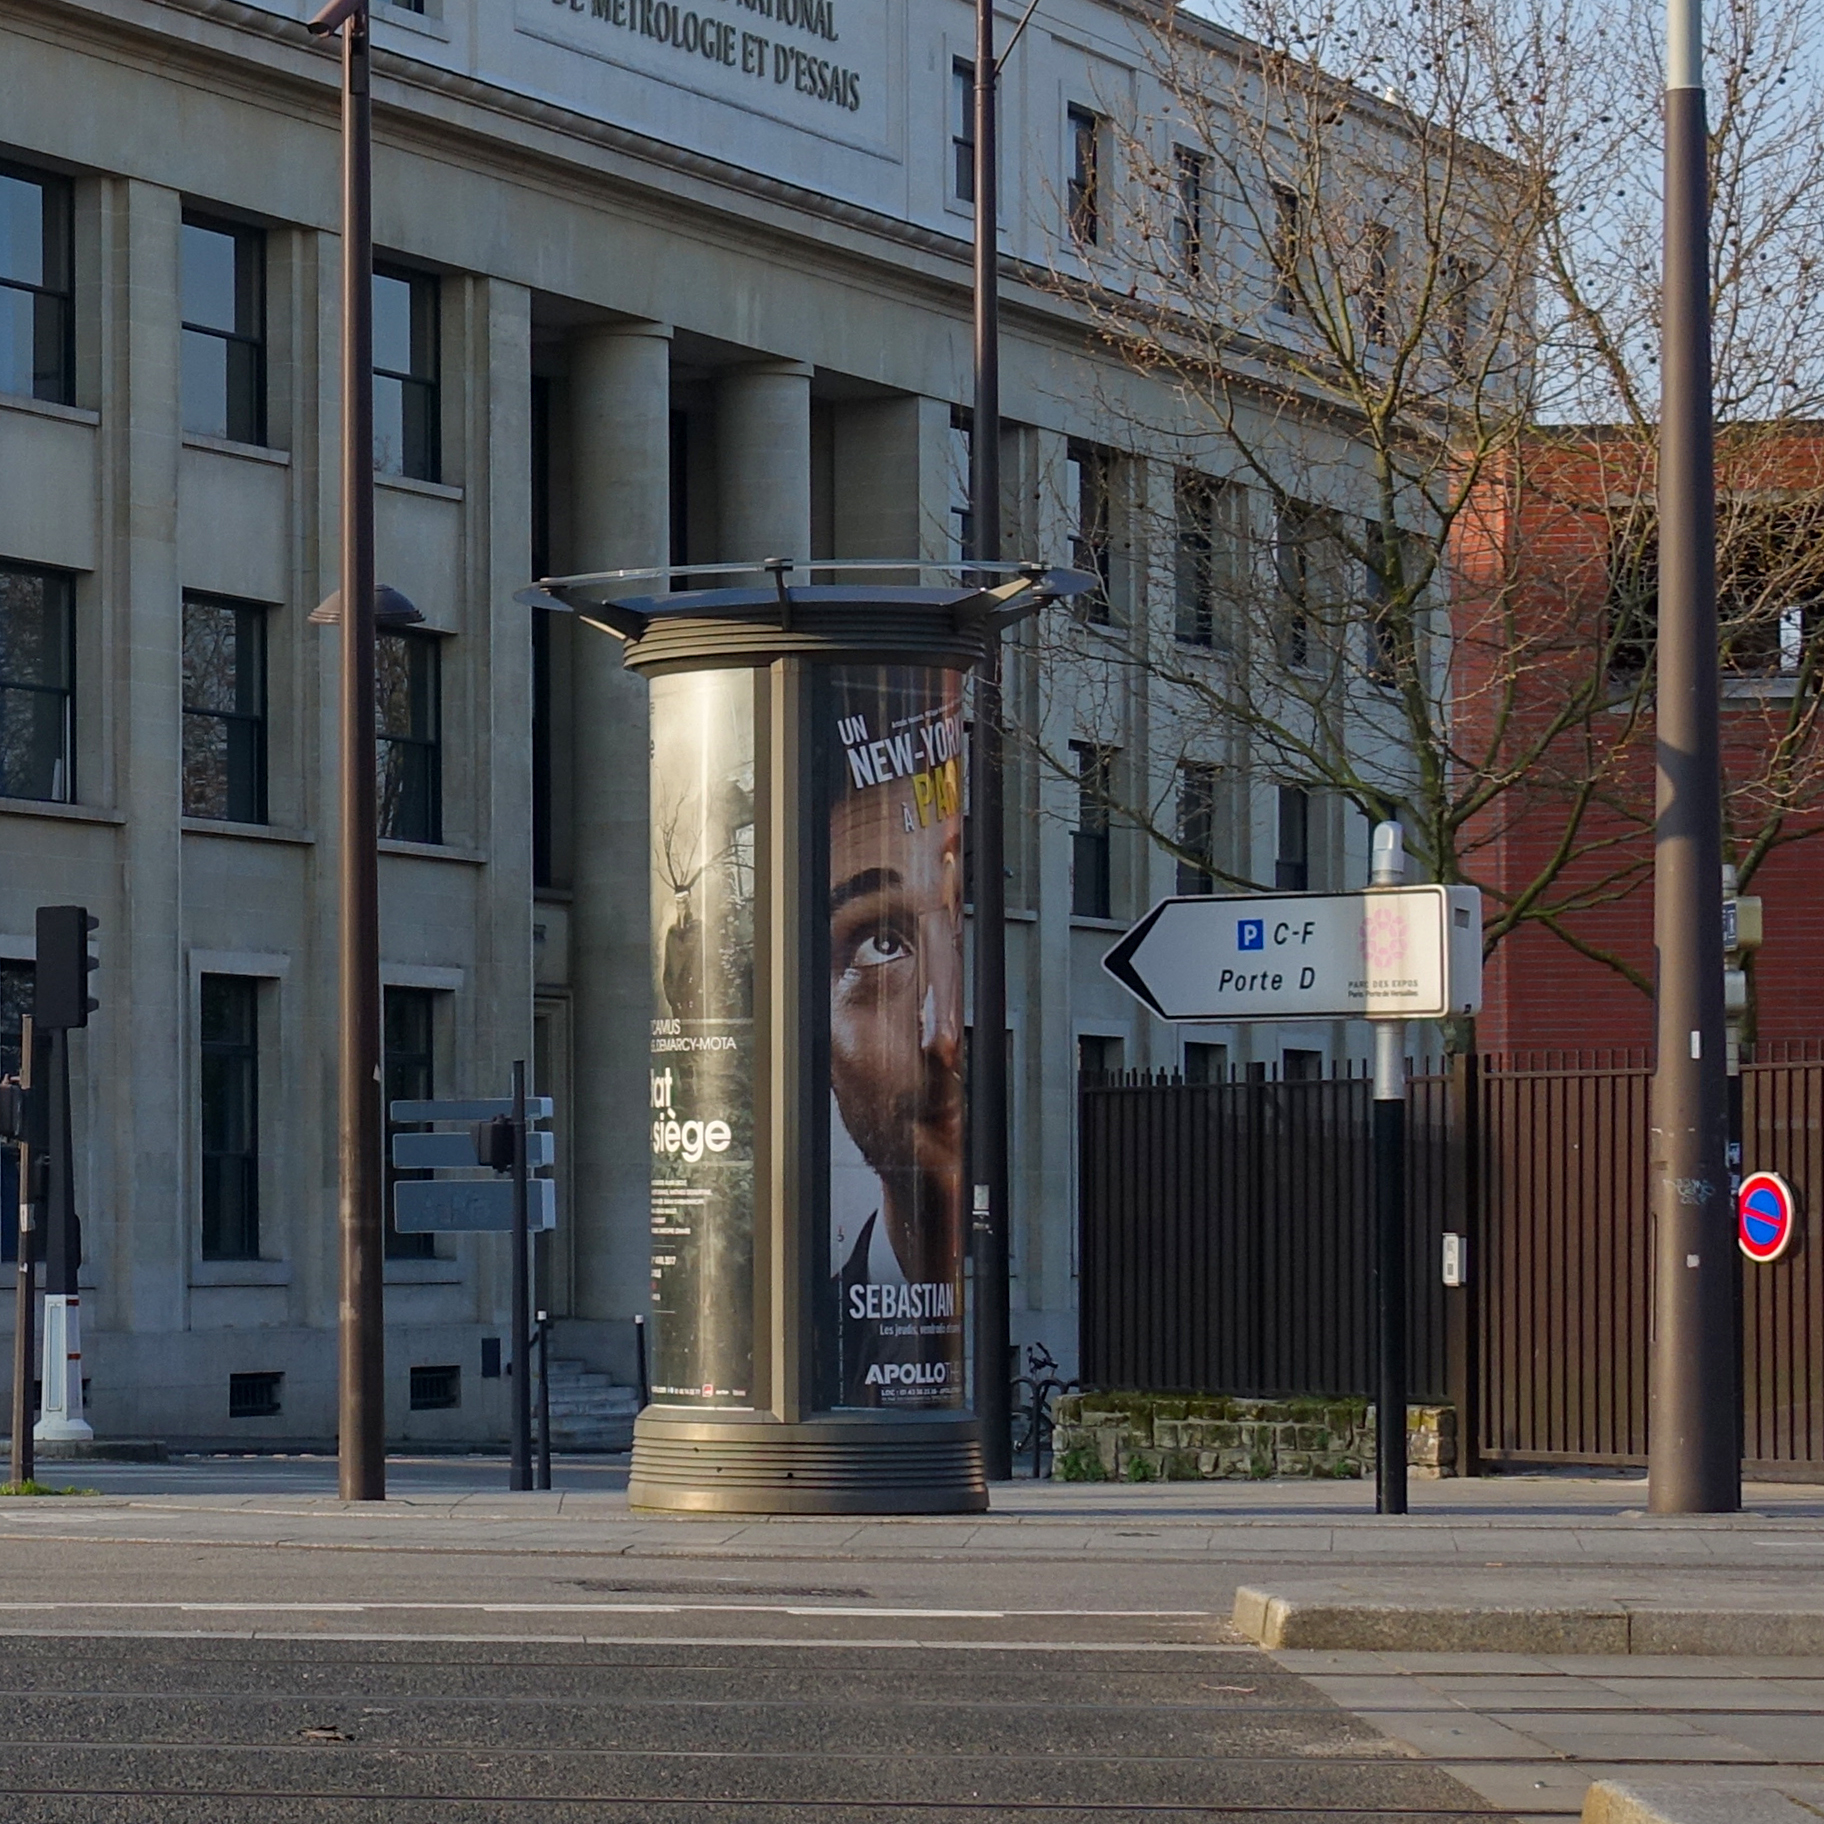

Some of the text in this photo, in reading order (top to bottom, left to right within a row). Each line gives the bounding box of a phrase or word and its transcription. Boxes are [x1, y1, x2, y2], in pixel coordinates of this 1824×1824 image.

[742, 31, 770, 77] ET
[773, 44, 861, 112] D'ESSAIS
[837, 714, 868, 745] UN
[901, 802, 916, 833] À
[1273, 922, 1316, 945] C-F
[1218, 967, 1316, 992] Porte D
[1348, 979, 1419, 988] PARC DES EXPOS
[653, 1108, 731, 1163] siège
[849, 1283, 954, 1319] SEBASTIAN
[880, 1324, 894, 1335] Les
[865, 1363, 945, 1385] APOLLO
